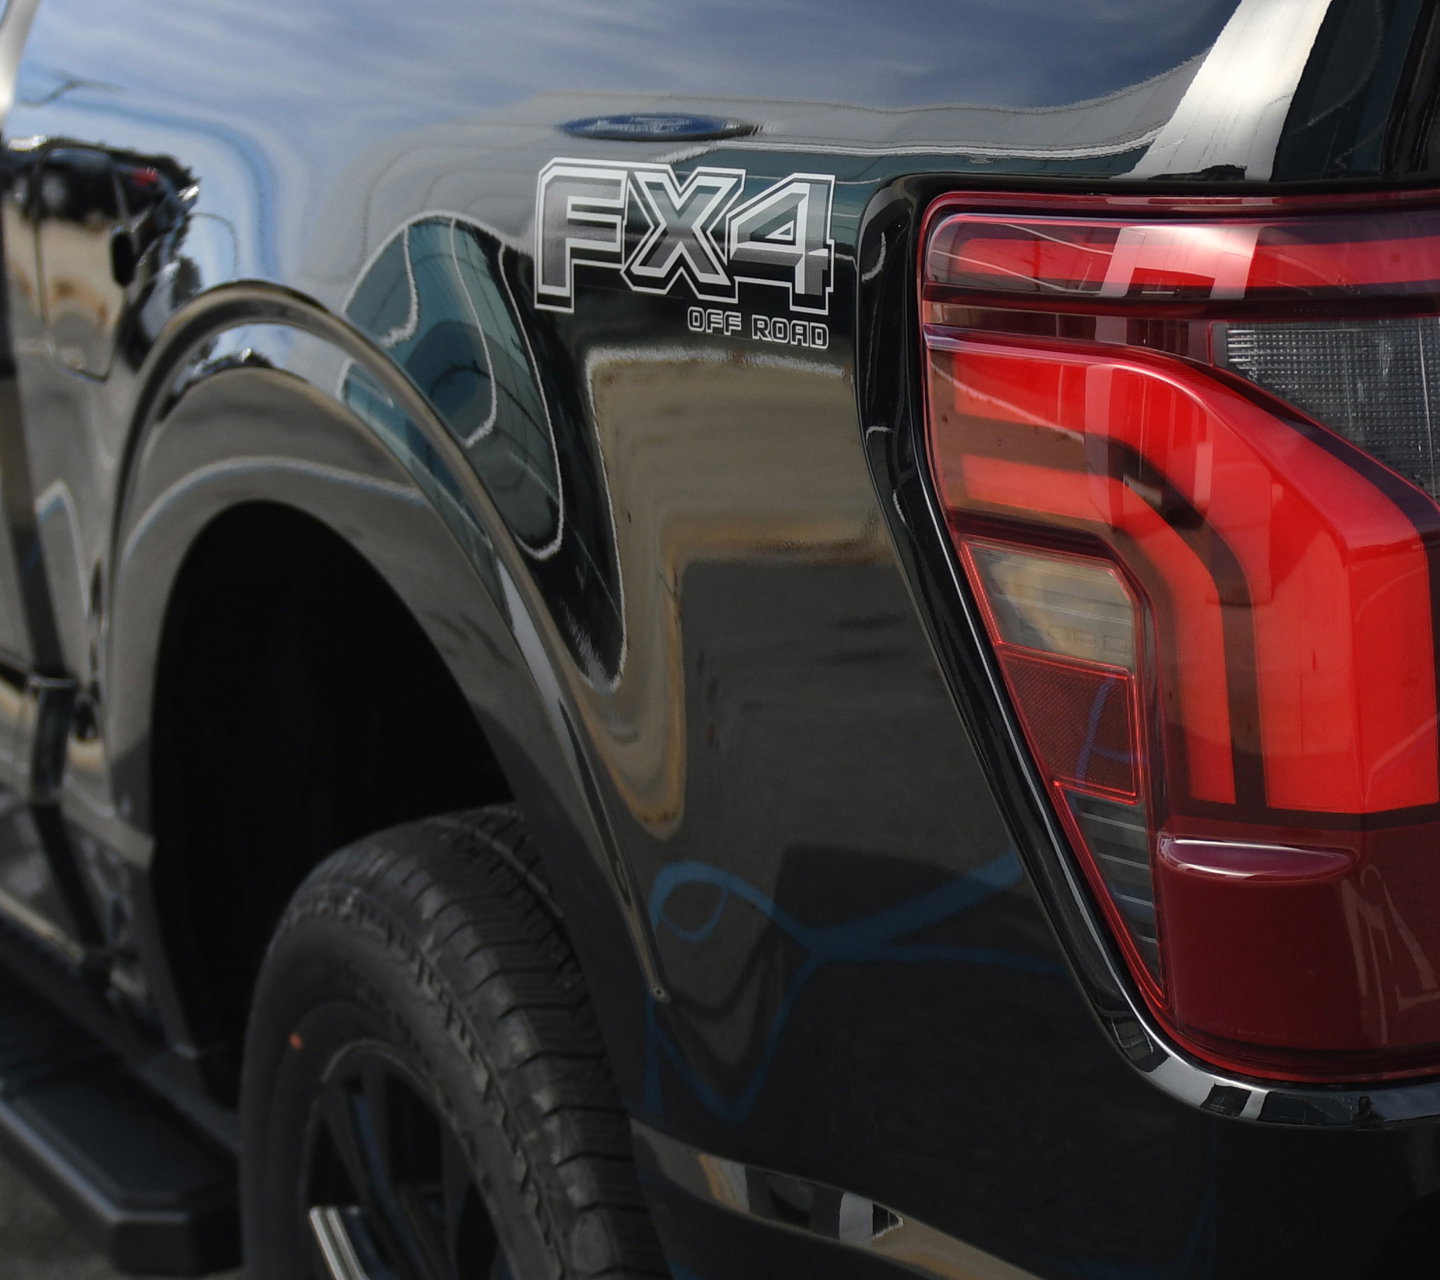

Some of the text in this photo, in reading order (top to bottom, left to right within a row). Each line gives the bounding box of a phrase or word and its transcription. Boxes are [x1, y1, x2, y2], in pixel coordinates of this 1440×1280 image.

[534, 157, 835, 314] FX4
[687, 307, 829, 349] OFF ROAD
